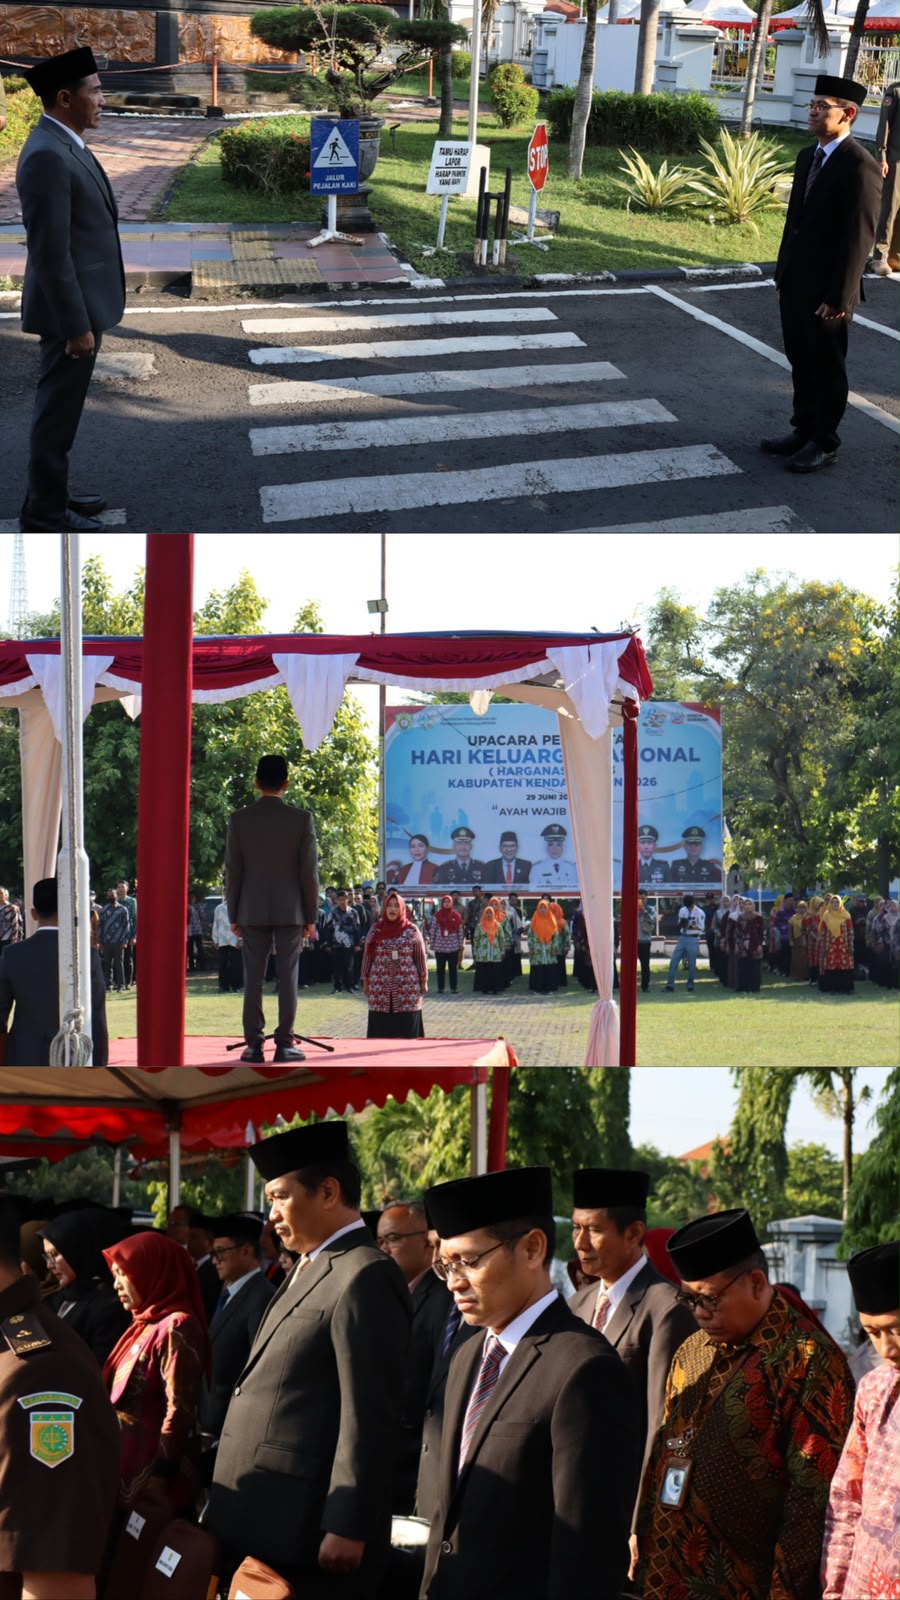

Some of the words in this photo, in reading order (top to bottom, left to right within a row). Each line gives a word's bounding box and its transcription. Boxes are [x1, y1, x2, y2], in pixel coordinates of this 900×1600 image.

[439, 147, 453, 156] TAMU
[529, 144, 548, 172] STOP
[467, 735, 538, 746] UPACARA
[411, 750, 461, 765] HARI
[468, 748, 564, 765] KELUARG
[448, 779, 522, 788] KABUPATEN
[526, 778, 566, 787] KENDA
[531, 807, 567, 816] WAJIB
